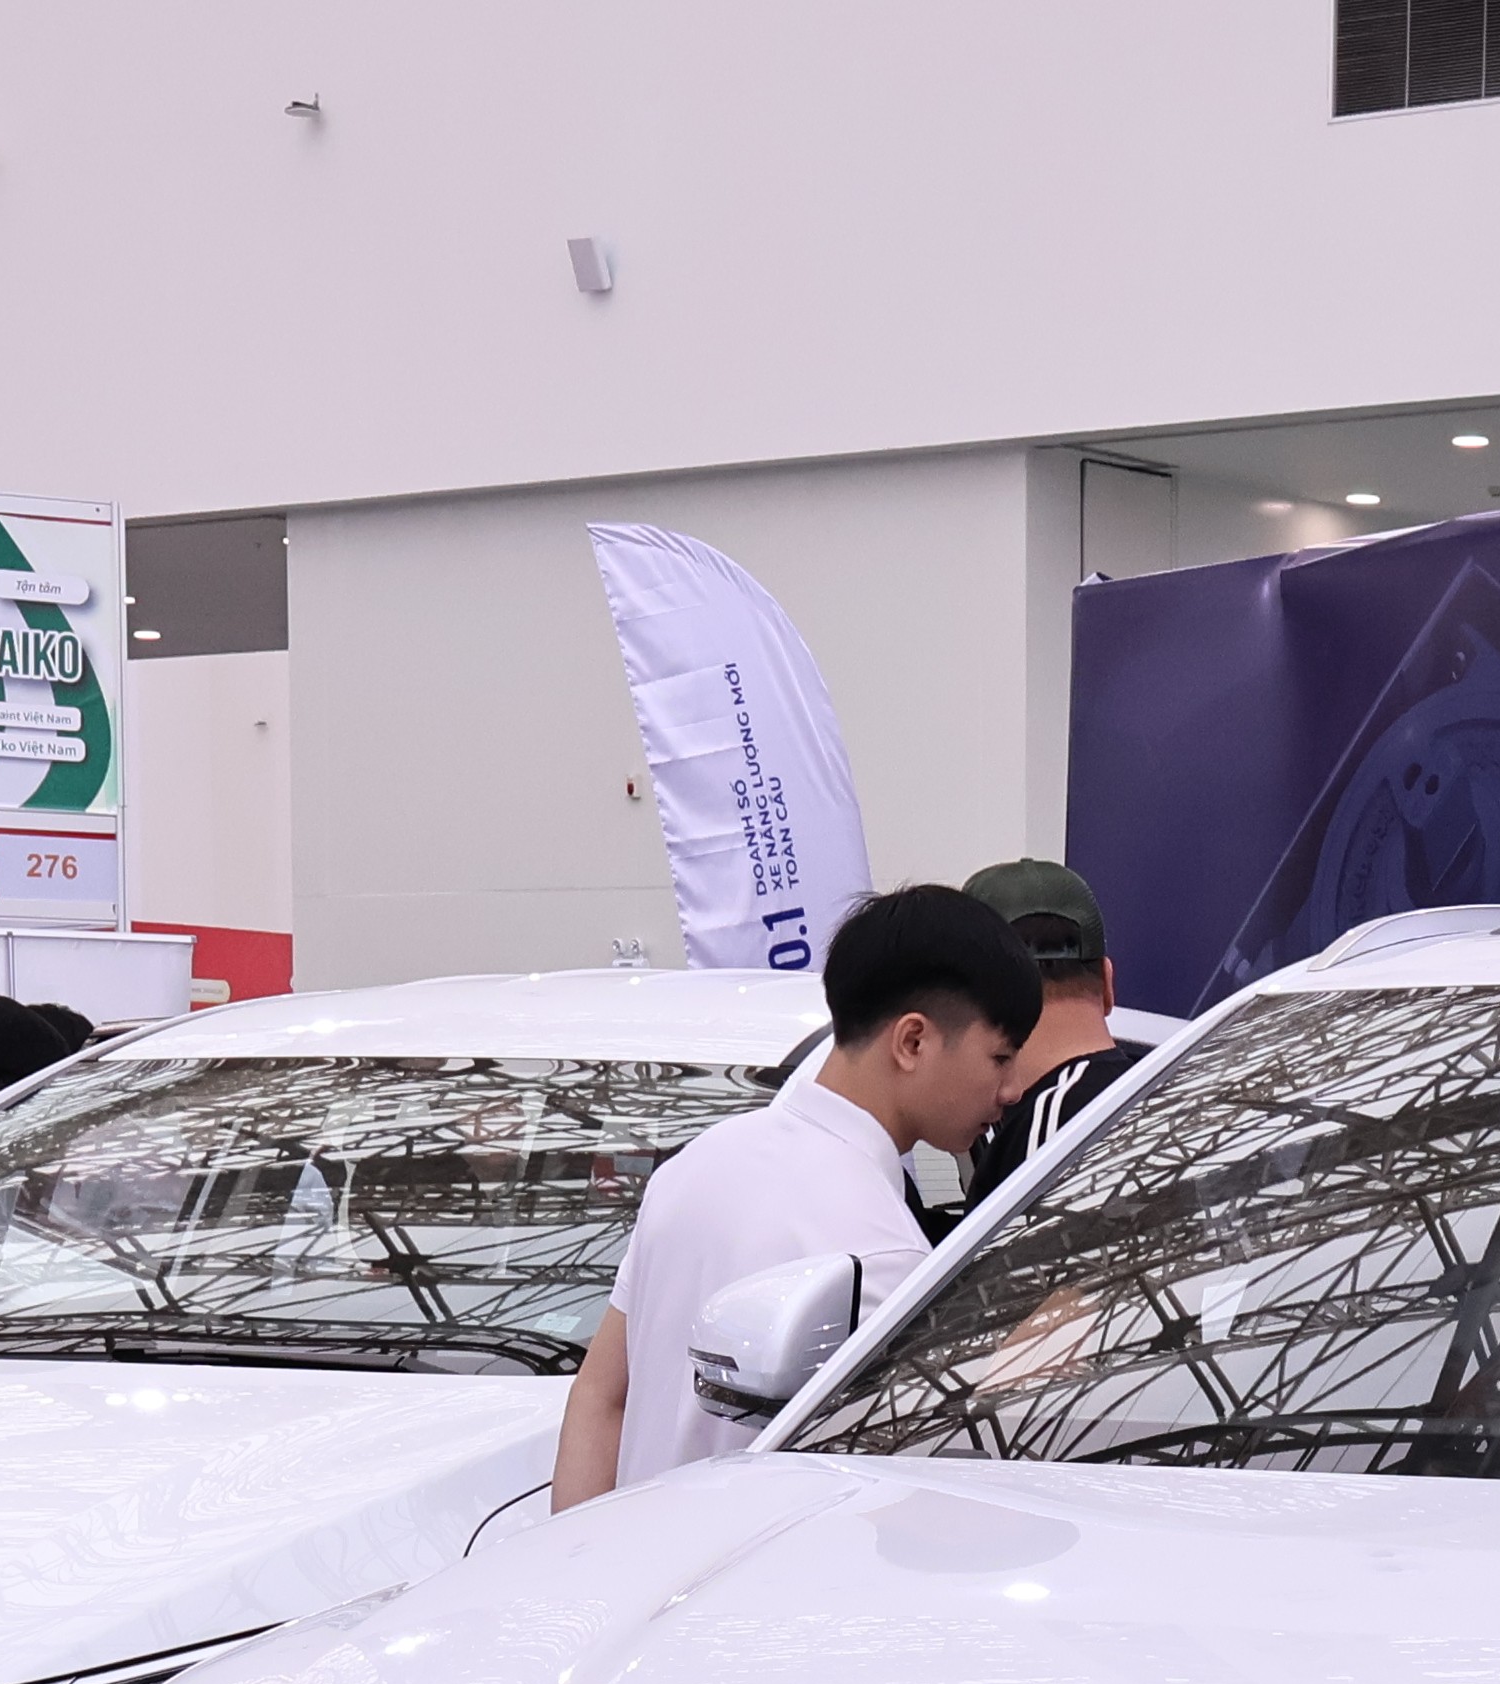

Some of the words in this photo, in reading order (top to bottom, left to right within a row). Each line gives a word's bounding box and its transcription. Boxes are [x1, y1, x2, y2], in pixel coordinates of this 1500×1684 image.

[23, 710, 44, 725] Việt
[47, 714, 72, 725] Nam
[731, 780, 750, 810] SỐ
[767, 777, 789, 821] CẦU
[26, 854, 78, 879] 276
[741, 816, 766, 895] DOANH
[780, 827, 799, 888] TOÀN
